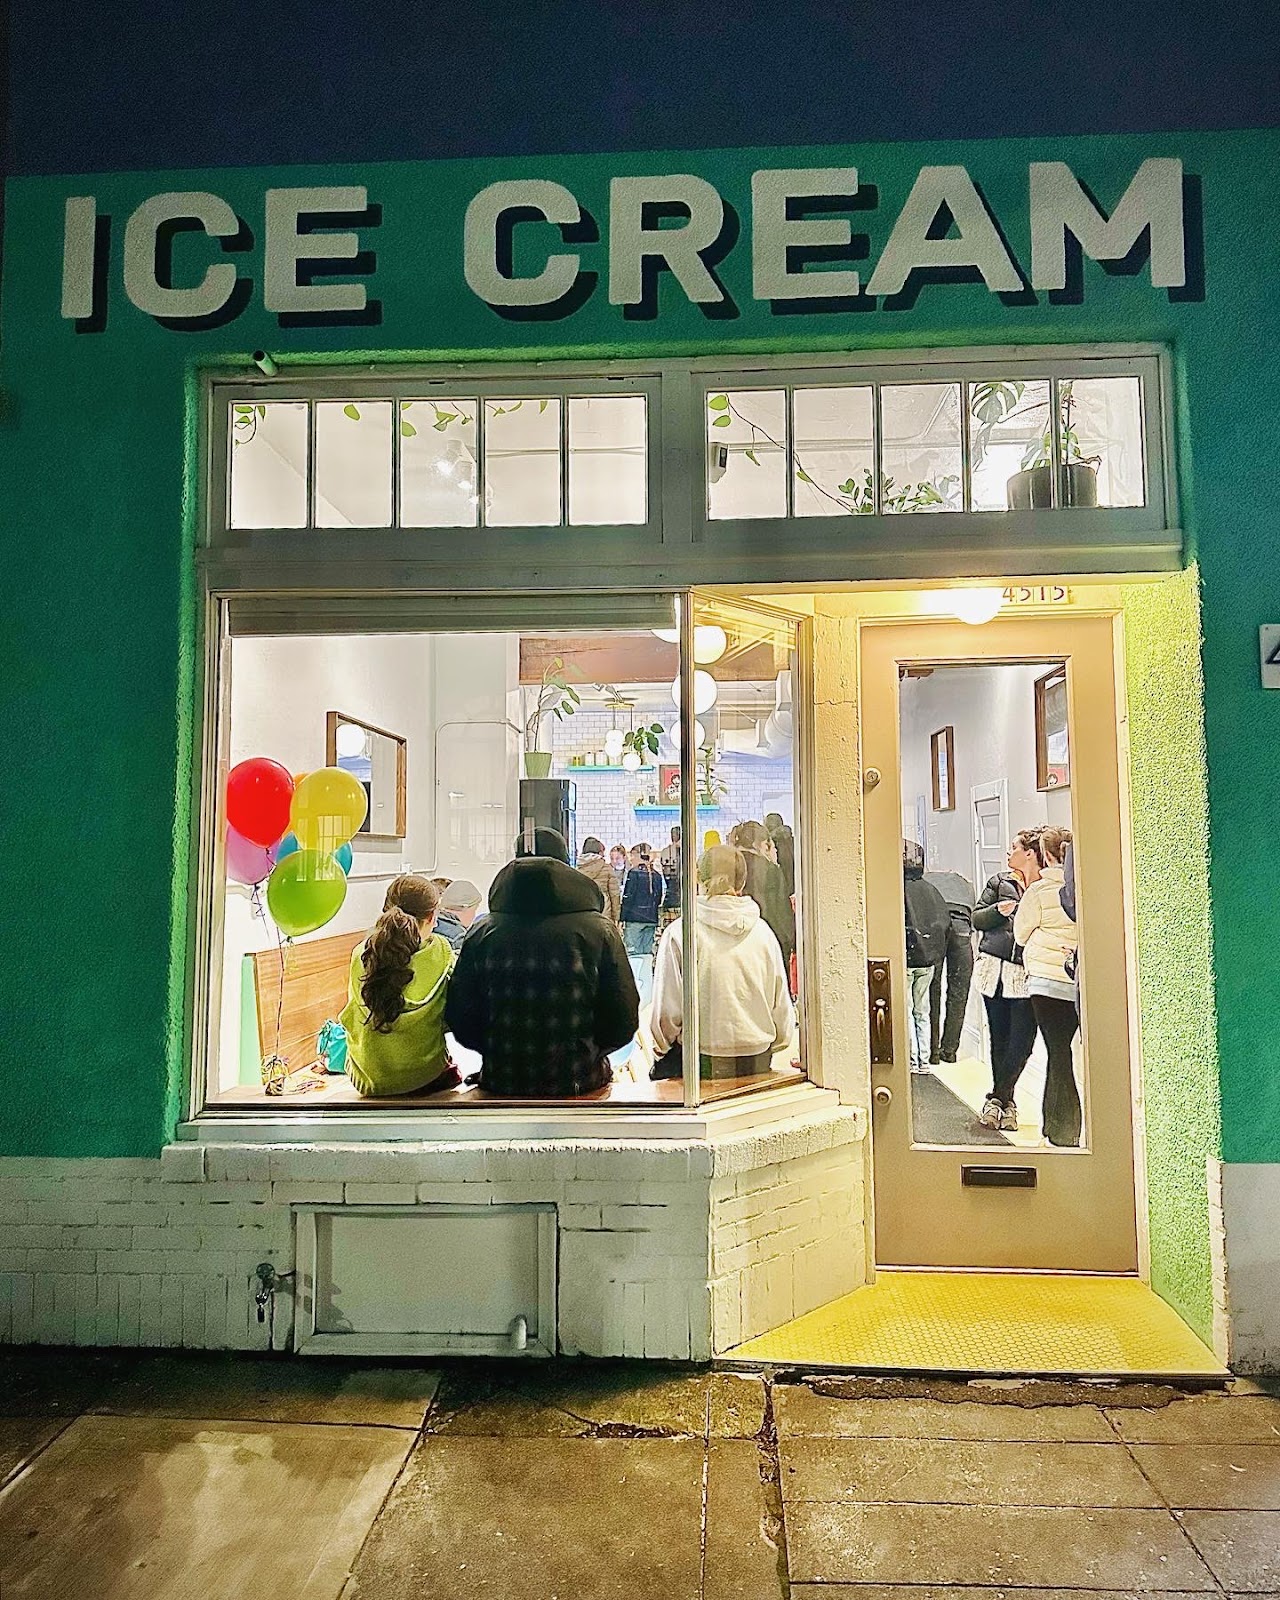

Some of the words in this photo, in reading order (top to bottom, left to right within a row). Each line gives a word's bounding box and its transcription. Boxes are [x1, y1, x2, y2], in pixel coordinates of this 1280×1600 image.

[61, 186, 367, 319] ICE
[463, 157, 1185, 308] CREAM
[1002, 585, 1065, 602] 4515
